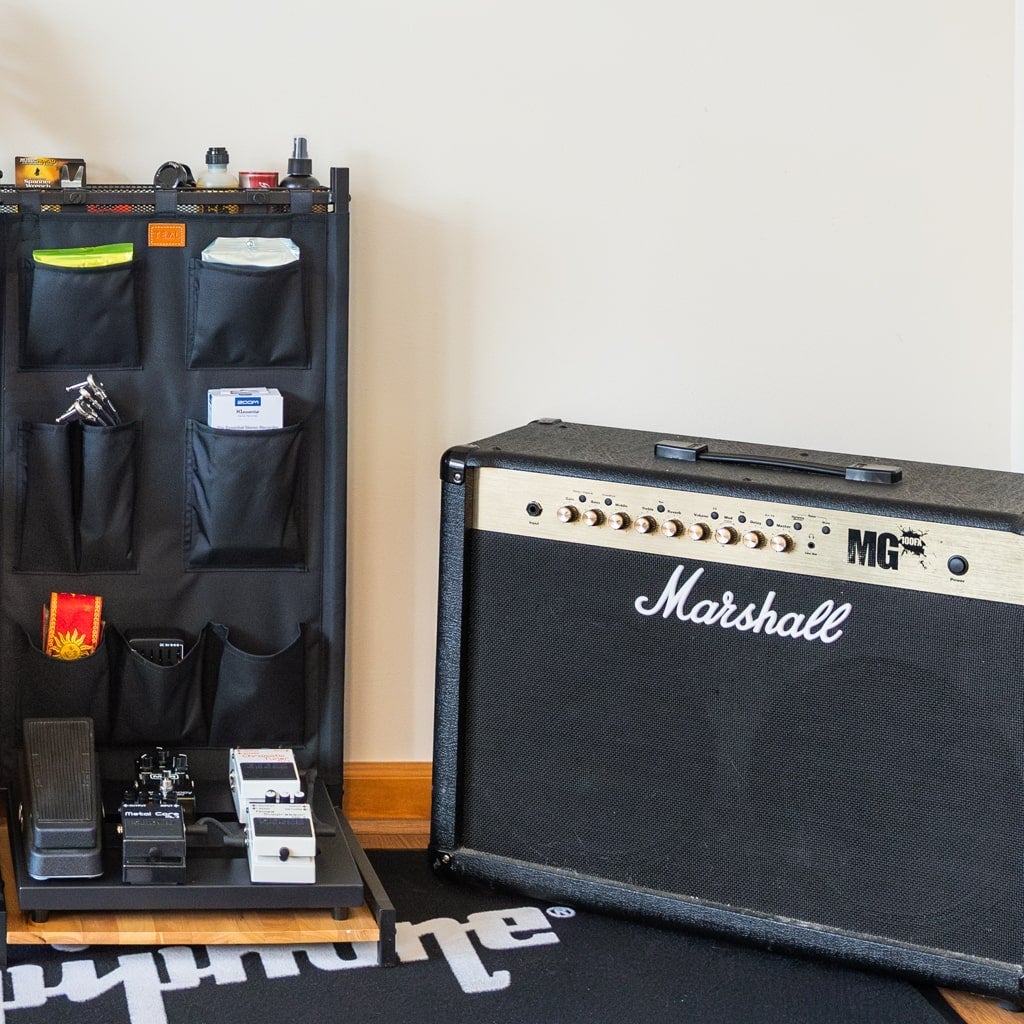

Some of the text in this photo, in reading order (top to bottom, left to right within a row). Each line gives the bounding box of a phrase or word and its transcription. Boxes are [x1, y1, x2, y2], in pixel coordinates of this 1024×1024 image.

[847, 528, 898, 570] MG
[901, 536, 922, 547] 100FX
[634, 564, 852, 644] Marshall
